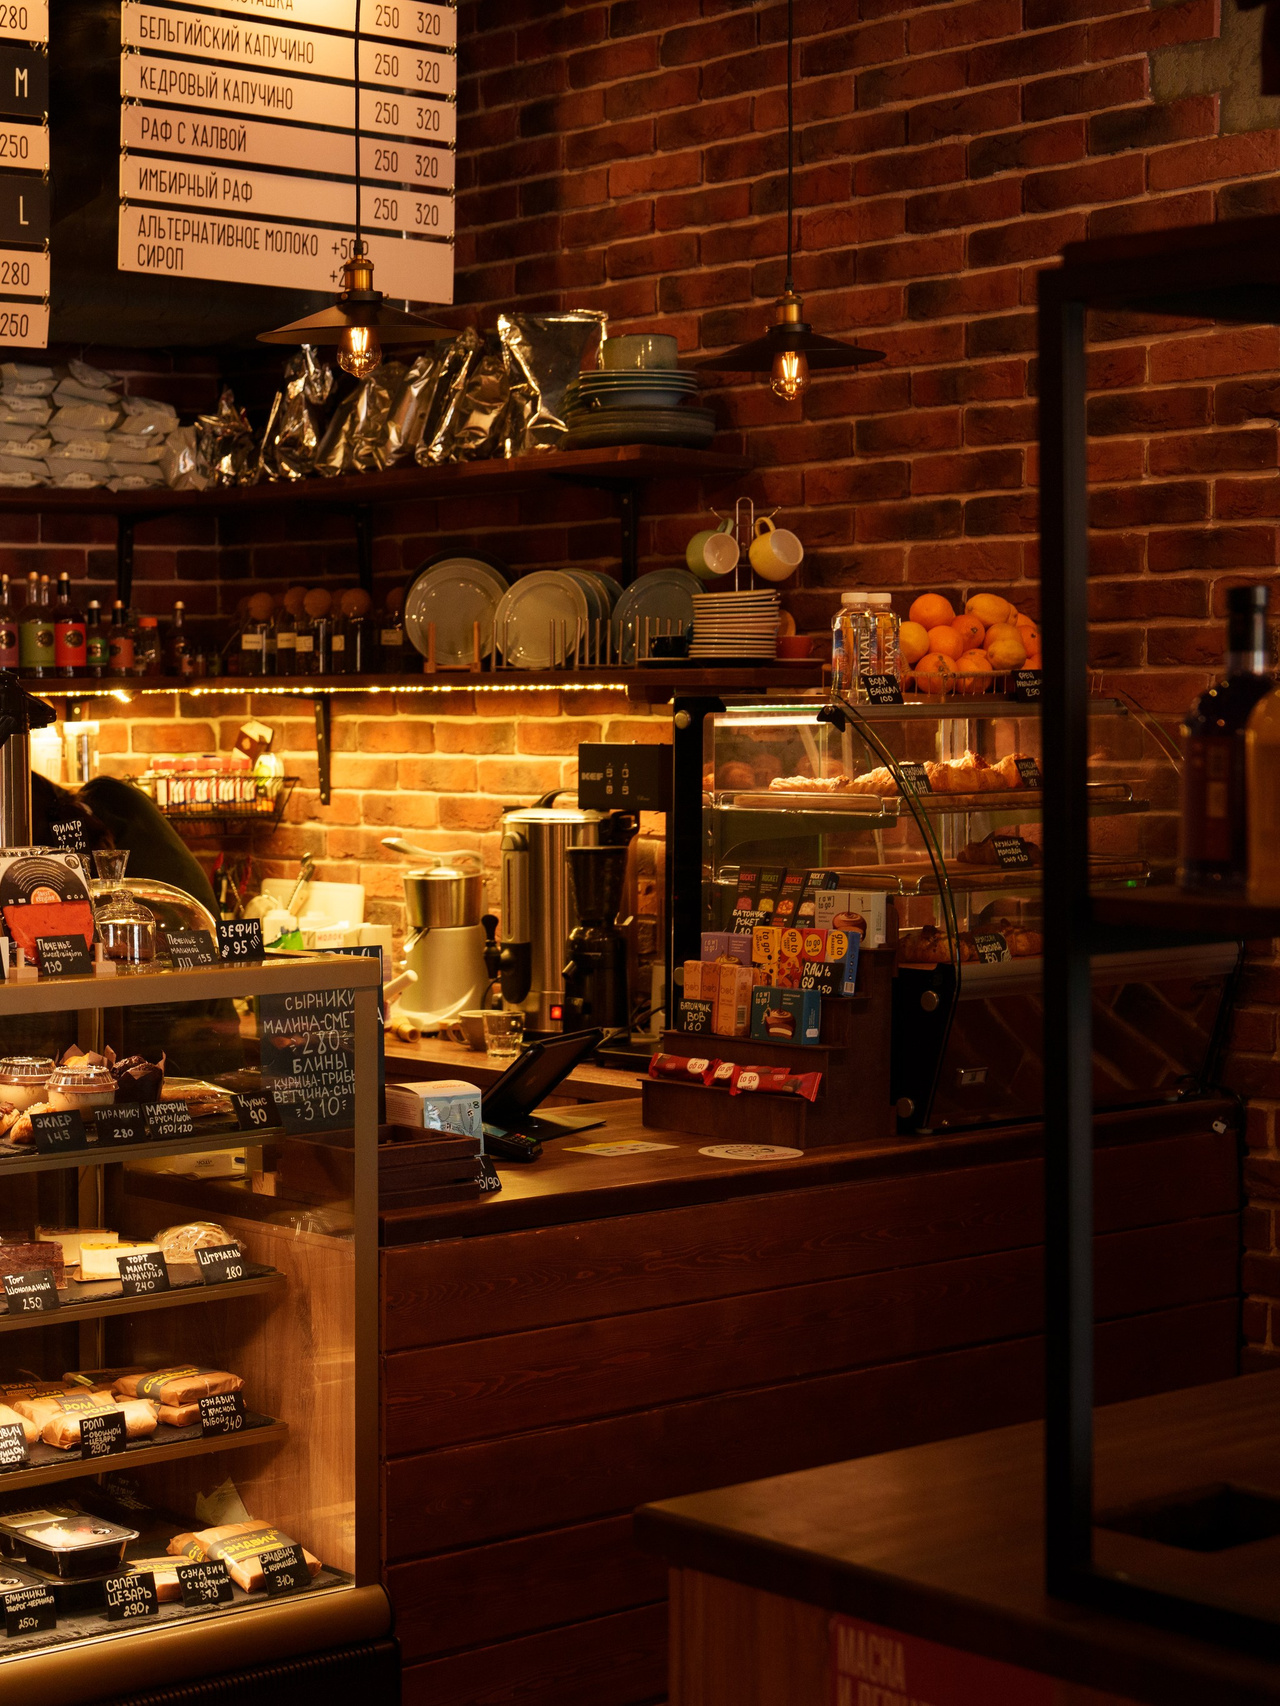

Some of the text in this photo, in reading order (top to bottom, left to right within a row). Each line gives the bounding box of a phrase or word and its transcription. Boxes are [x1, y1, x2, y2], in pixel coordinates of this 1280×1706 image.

[0, 5, 28, 31] 280
[375, 5, 441, 36] 250 320
[139, 15, 440, 84] БЕЛЬГИЙСКИЙ КАПУЧИНО 250 320
[16, 68, 28, 98] M
[140, 66, 440, 132] КЕДРОВЫЙ КАПУЧИНО 250 320
[0, 134, 28, 159] 250
[141, 116, 439, 178] РАФ С ХАЛВОЙ 250 320
[139, 167, 439, 227] ИМБИРНЫЙ РАФ 250 320
[20, 196, 29, 225] L
[138, 214, 319, 257] АЛЬТЕРНАТИВНОЕ МОЛОКО
[137, 244, 184, 271] СИРОП
[1, 261, 30, 286] 280
[0, 313, 29, 337] 250
[868, 676, 888, 687] ВОДА
[870, 685, 899, 697] БАЙКАЛ
[879, 694, 894, 703] 100
[1026, 687, 1041, 697] 250
[581, 772, 603, 780] KEF
[53, 820, 81, 836] ФИЛЬТР
[740, 873, 756, 881] ROCKET
[761, 875, 778, 883] ROCKET
[220, 922, 260, 938] ЗЕФИР
[233, 940, 248, 955] 95
[198, 953, 212, 964] 155
[44, 961, 62, 974] 130
[803, 962, 824, 976] RAW
[802, 977, 815, 989] GO
[680, 1001, 711, 1013] БАТОНЧИК
[684, 1022, 701, 1031] 180
[302, 1029, 340, 1055] 280
[292, 1052, 348, 1074] БЛИНЫ
[740, 1075, 757, 1085] to go
[94, 1108, 140, 1121] ТИРАМИСУ
[146, 1103, 188, 1117] МАФФИН
[304, 1096, 340, 1121] 310
[36, 1115, 72, 1129] ЭКЛЕР
[250, 1109, 267, 1125] 90
[47, 1129, 70, 1144] 145
[113, 1128, 134, 1139] 280
[158, 1124, 193, 1135] 150/120
[127, 1254, 148, 1263] ТОРТ
[198, 1249, 241, 1266] ШТРУДЕЛЬ
[226, 1266, 243, 1280] 180
[135, 1280, 155, 1292] 240
[22, 1297, 42, 1310] 250
[64, 1402, 96, 1411] РОЛЛ
[200, 1395, 235, 1407] СЭНДВИЧ
[83, 1405, 116, 1416] РОЛЛ
[83, 1418, 105, 1430] РОЛЛ
[223, 1415, 242, 1431] 340
[217, 1535, 277, 1559] СЭНДВИЧ
[260, 1547, 294, 1564] СЭНДВИЧ
[181, 1564, 224, 1580] СЭНДВИЧ
[106, 1575, 141, 1592] САЛАТ
[5, 1589, 46, 1604] БЛИНЧИКИ
[107, 1587, 152, 1607] ЦЕЗАРЬ
